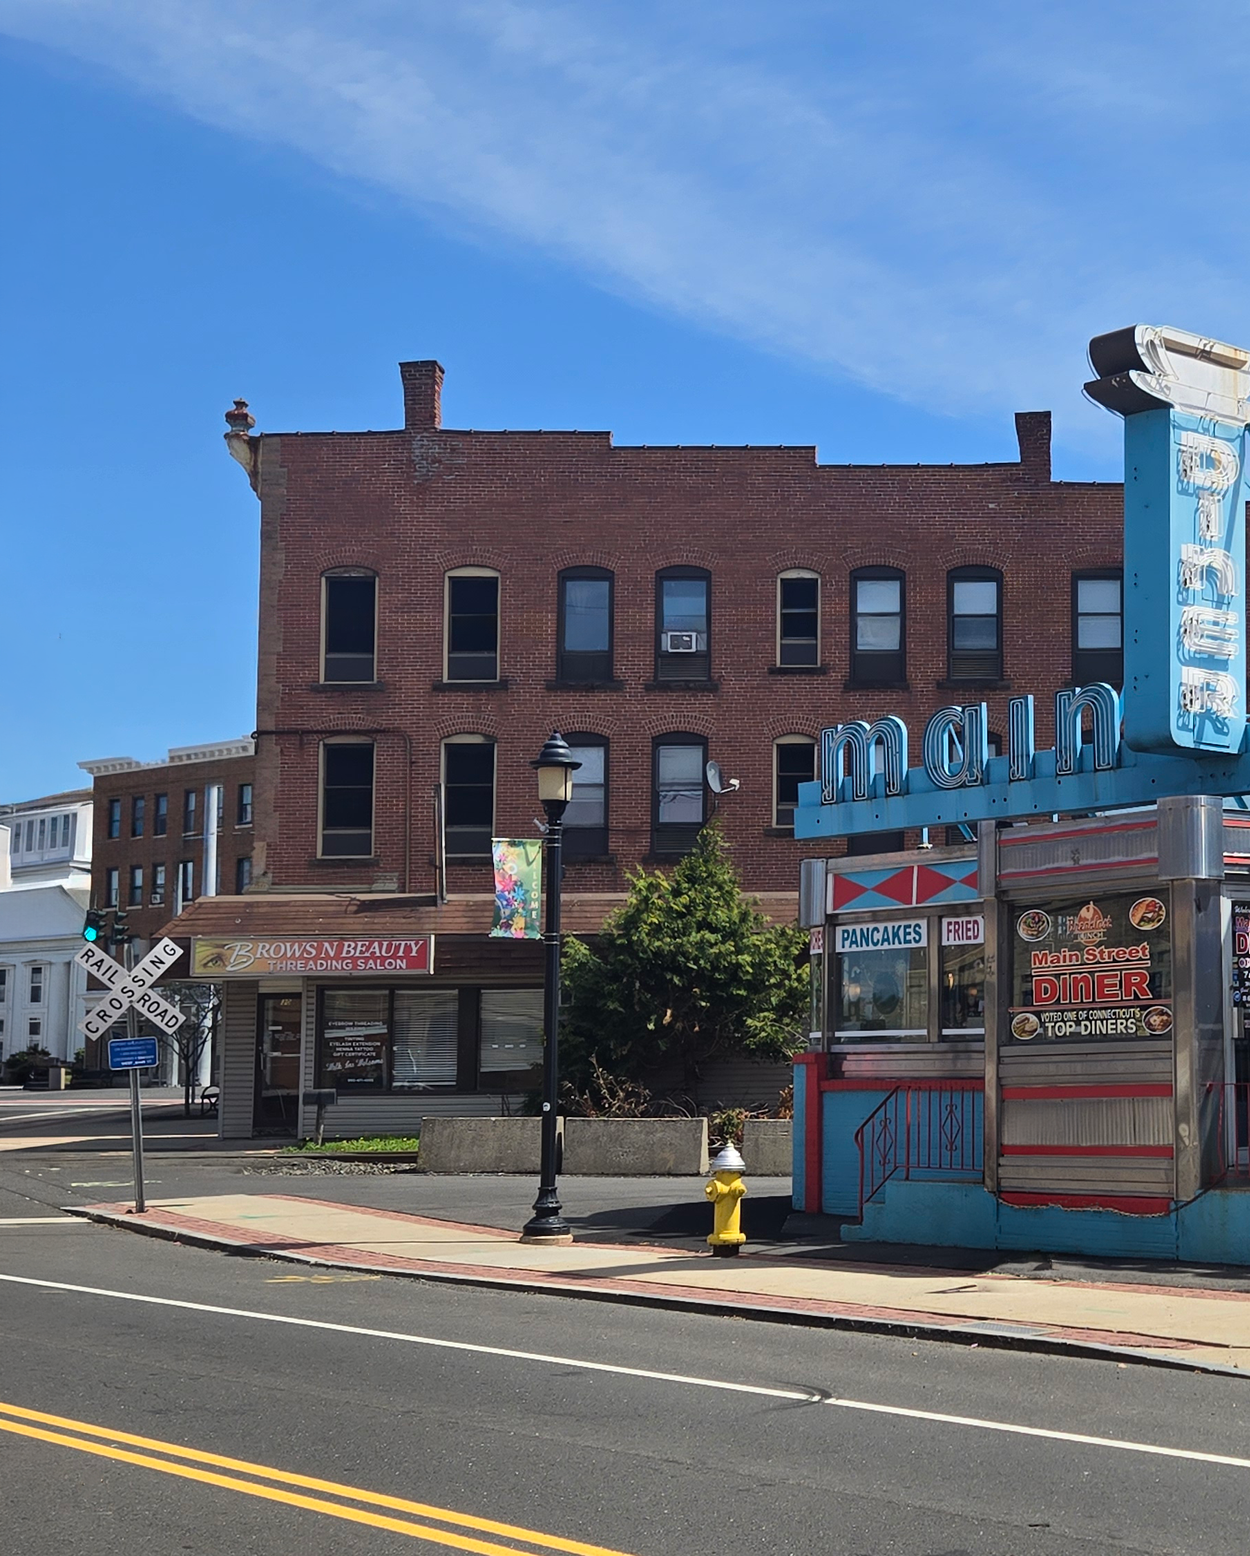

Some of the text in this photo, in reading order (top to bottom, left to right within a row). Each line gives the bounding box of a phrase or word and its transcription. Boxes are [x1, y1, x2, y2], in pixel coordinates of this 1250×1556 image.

[821, 682, 1122, 804] main
[841, 922, 922, 948] PANCAKES
[946, 919, 980, 941] FRIED
[224, 940, 424, 971] BROWS N BEAUTY
[268, 959, 407, 971] THREADING SALON
[1031, 941, 1150, 968] Main Street
[80, 948, 179, 1029] RAIL ROAD
[85, 944, 176, 1034] CROSSING
[1041, 1012, 1062, 1022] VOTED
[1063, 1011, 1077, 1021] ONE
[1078, 1011, 1087, 1020] OF
[1045, 1019, 1137, 1037] TOP DINERS
